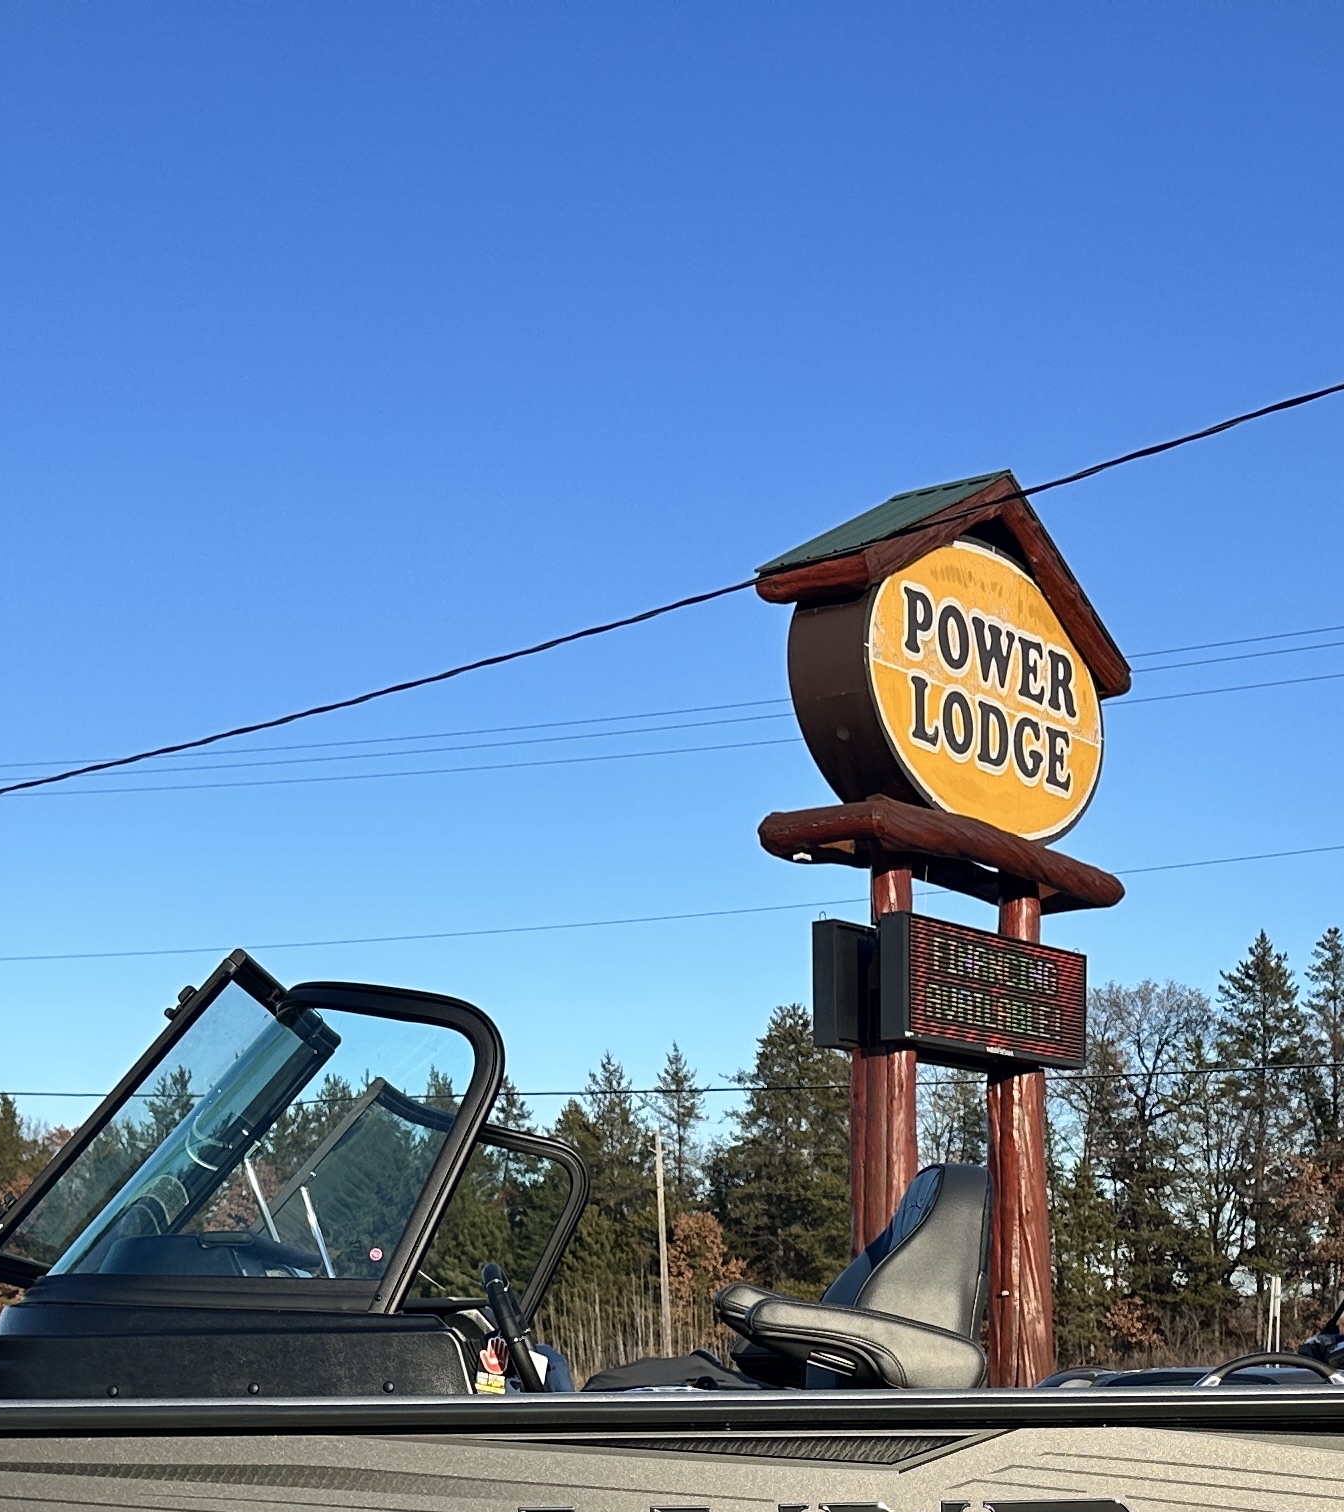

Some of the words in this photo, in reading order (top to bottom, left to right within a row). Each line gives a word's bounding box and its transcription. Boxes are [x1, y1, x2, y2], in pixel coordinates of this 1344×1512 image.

[903, 586, 1077, 718] POWER
[910, 675, 1071, 793] LODGE
[932, 936, 1057, 994] FINANCING
